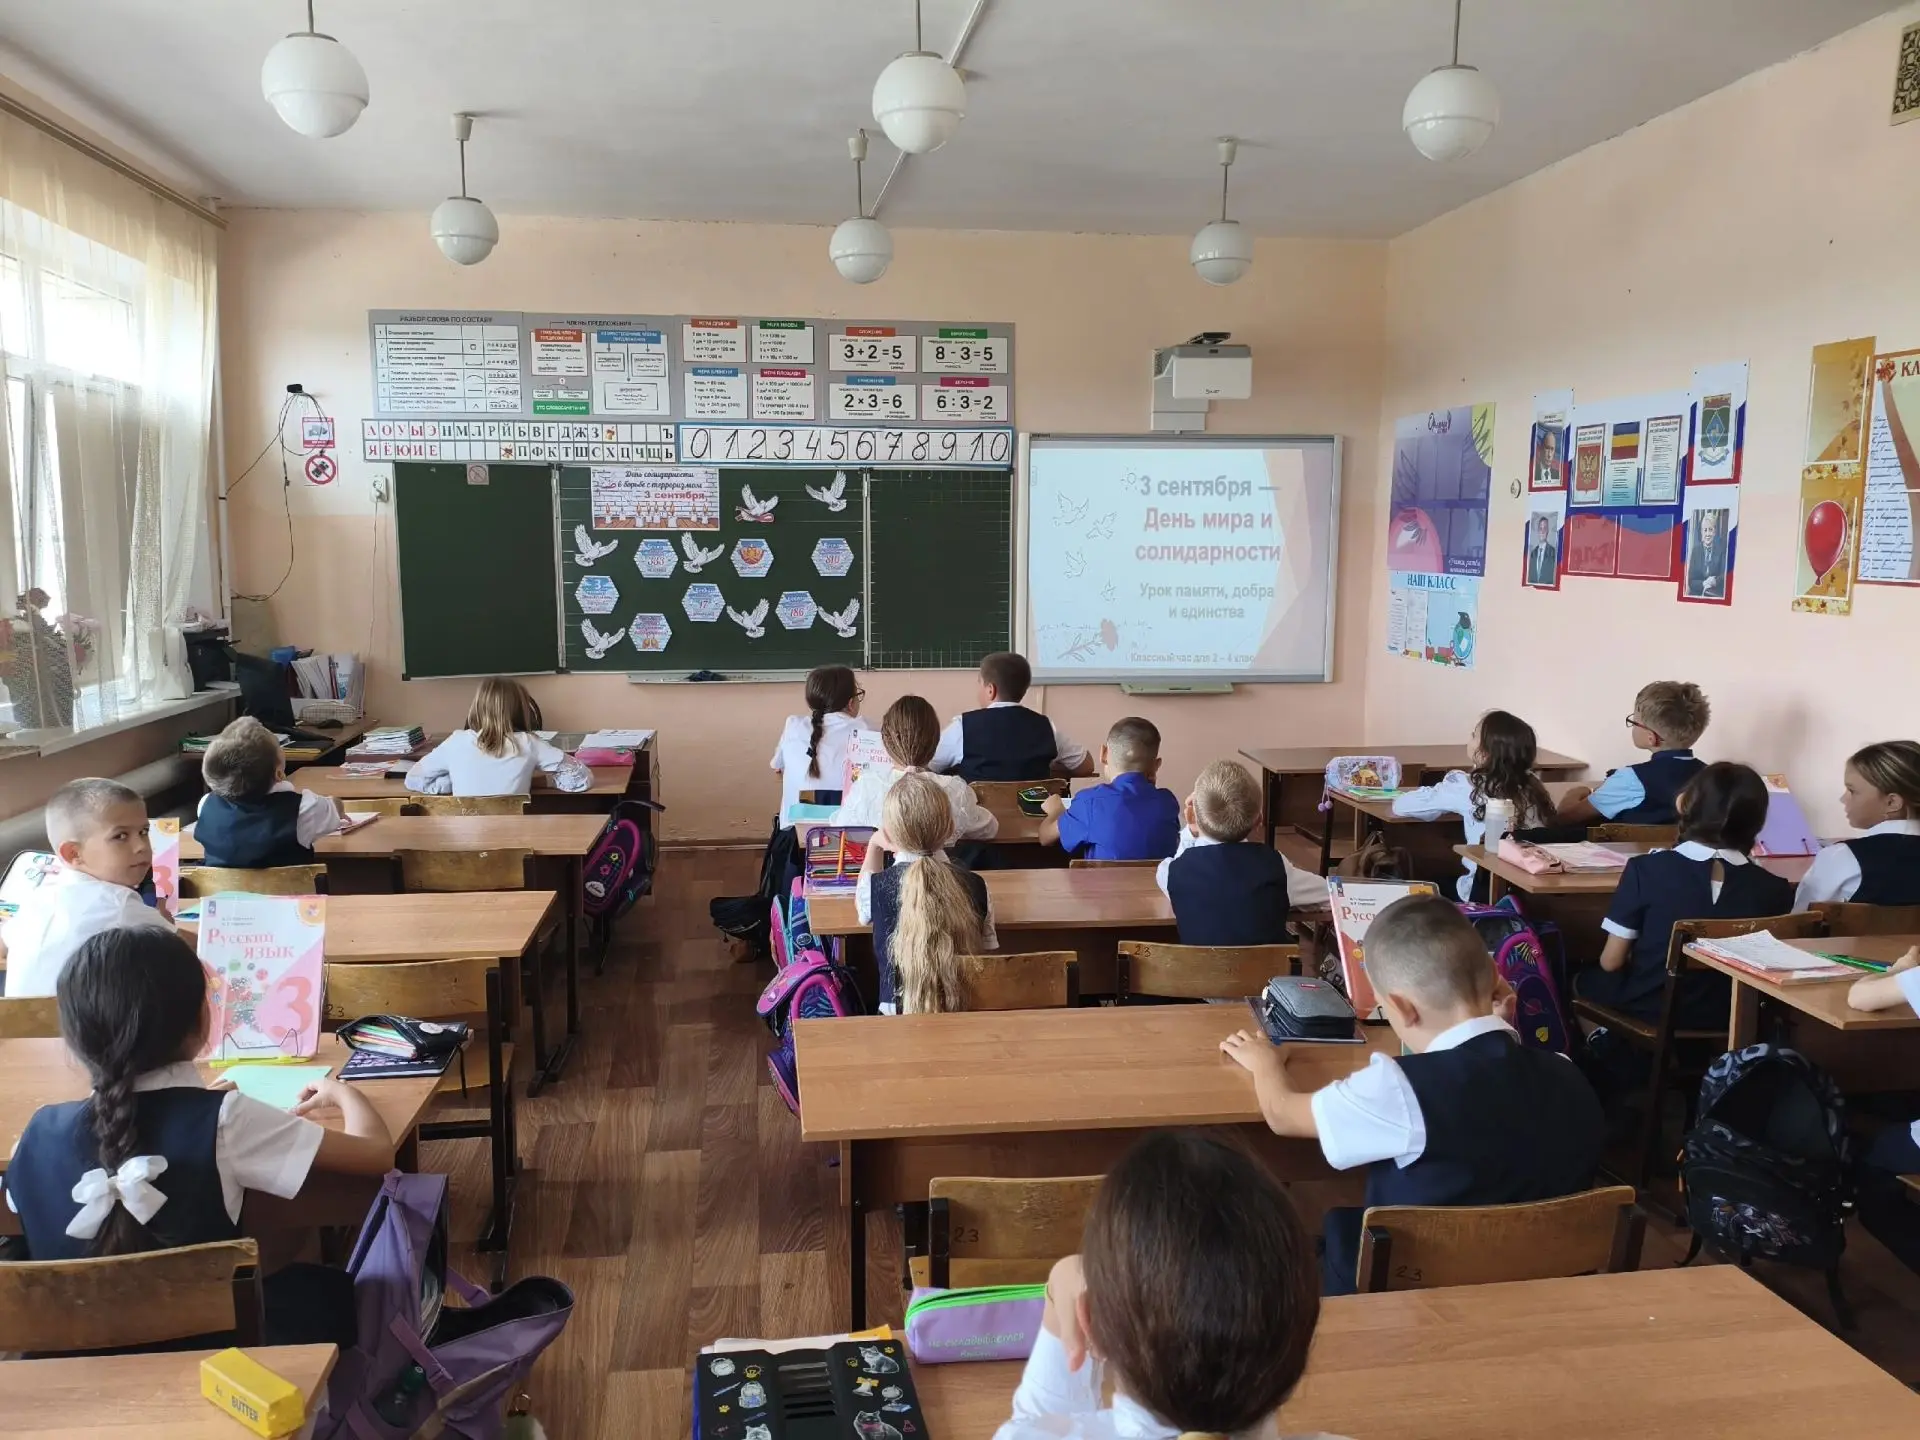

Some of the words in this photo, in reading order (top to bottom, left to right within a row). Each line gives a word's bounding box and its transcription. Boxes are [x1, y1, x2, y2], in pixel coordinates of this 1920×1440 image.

[844, 344, 854, 358] 3
[868, 345, 878, 359] 2
[892, 345, 902, 359] 5
[936, 346, 945, 360] 8
[960, 346, 970, 360] 3
[983, 347, 993, 361] 5
[844, 394, 854, 408] 2
[868, 394, 878, 408] 3
[892, 394, 902, 408] 6
[937, 395, 946, 408] 6
[960, 396, 970, 409] 3
[983, 396, 993, 409] 2
[368, 425, 376, 436] А
[382, 425, 392, 436] О
[395, 426, 404, 436] У
[411, 426, 423, 436] Ы
[428, 426, 437, 436] Э
[442, 426, 451, 436] Н
[456, 426, 468, 436] М
[472, 426, 481, 436] Л
[488, 426, 496, 436] Р
[503, 422, 511, 436] Й
[518, 427, 526, 437] Б
[533, 427, 541, 437] В
[548, 427, 555, 437] Г
[561, 427, 571, 439] Д
[574, 427, 588, 438] Ж
[592, 427, 599, 438] З
[663, 428, 673, 439] Ъ
[368, 444, 377, 456] Я
[384, 442, 392, 456] Ё
[396, 445, 410, 456] Ю
[414, 445, 423, 456] И
[430, 445, 438, 456] Е
[518, 446, 527, 457] П
[532, 446, 543, 457] Ф
[549, 447, 558, 457] К
[563, 447, 572, 457] Т
[575, 447, 588, 457] Ш
[592, 447, 600, 458] С
[606, 447, 615, 458] Х
[621, 448, 630, 459] Ц
[635, 448, 644, 458] Ч
[648, 448, 662, 460] Щ
[666, 448, 673, 458] Ь
[691, 429, 708, 459] 0
[725, 429, 738, 459] 1
[747, 429, 767, 460] 2
[774, 431, 794, 460] 3
[806, 430, 821, 460] 4
[827, 431, 849, 460] 5
[855, 432, 874, 460] 6
[884, 432, 902, 460] 7
[912, 432, 929, 461] 8
[938, 432, 957, 461] 9
[971, 432, 1010, 462] 10
[644, 471, 694, 479] солидарности
[655, 491, 705, 501] сентября
[1140, 475, 1152, 496] 3
[1157, 475, 1252, 502] сентября
[1144, 507, 1196, 531] День
[1202, 512, 1254, 534] мира
[1261, 512, 1273, 528] и
[1135, 544, 1280, 565] солидарности
[1408, 574, 1425, 586] НАШ
[1428, 575, 1456, 590] КЛАСС
[1140, 582, 1171, 599] Урок
[1176, 584, 1228, 599] памяти,
[1232, 584, 1274, 600] добра
[791, 608, 804, 617] 186
[1169, 608, 1177, 618] и
[1181, 606, 1244, 621] единства
[1131, 652, 1175, 662] Классный
[1176, 654, 1191, 662] час
[1193, 654, 1210, 664] для
[1212, 654, 1219, 662] 2
[1227, 654, 1233, 662] 4
[207, 928, 274, 945] Русский
[270, 976, 313, 1037] 3
[231, 1394, 259, 1422] BUTTER
